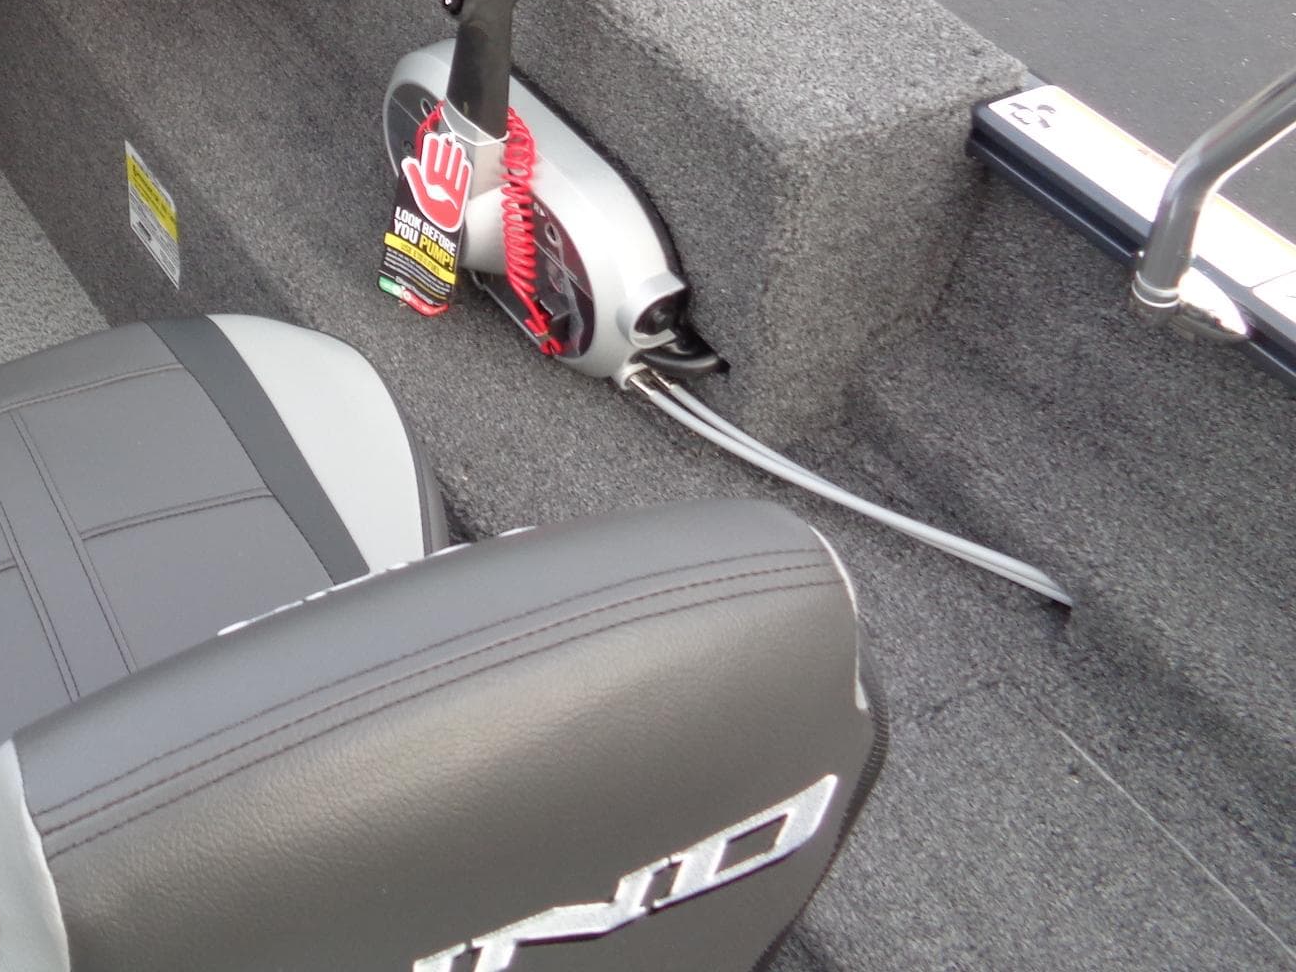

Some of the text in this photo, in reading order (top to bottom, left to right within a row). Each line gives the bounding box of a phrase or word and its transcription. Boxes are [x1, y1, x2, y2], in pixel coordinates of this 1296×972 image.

[394, 219, 419, 245] YOU
[419, 234, 456, 271] PUMP!
[395, 206, 457, 257] LOOK BEFORE
